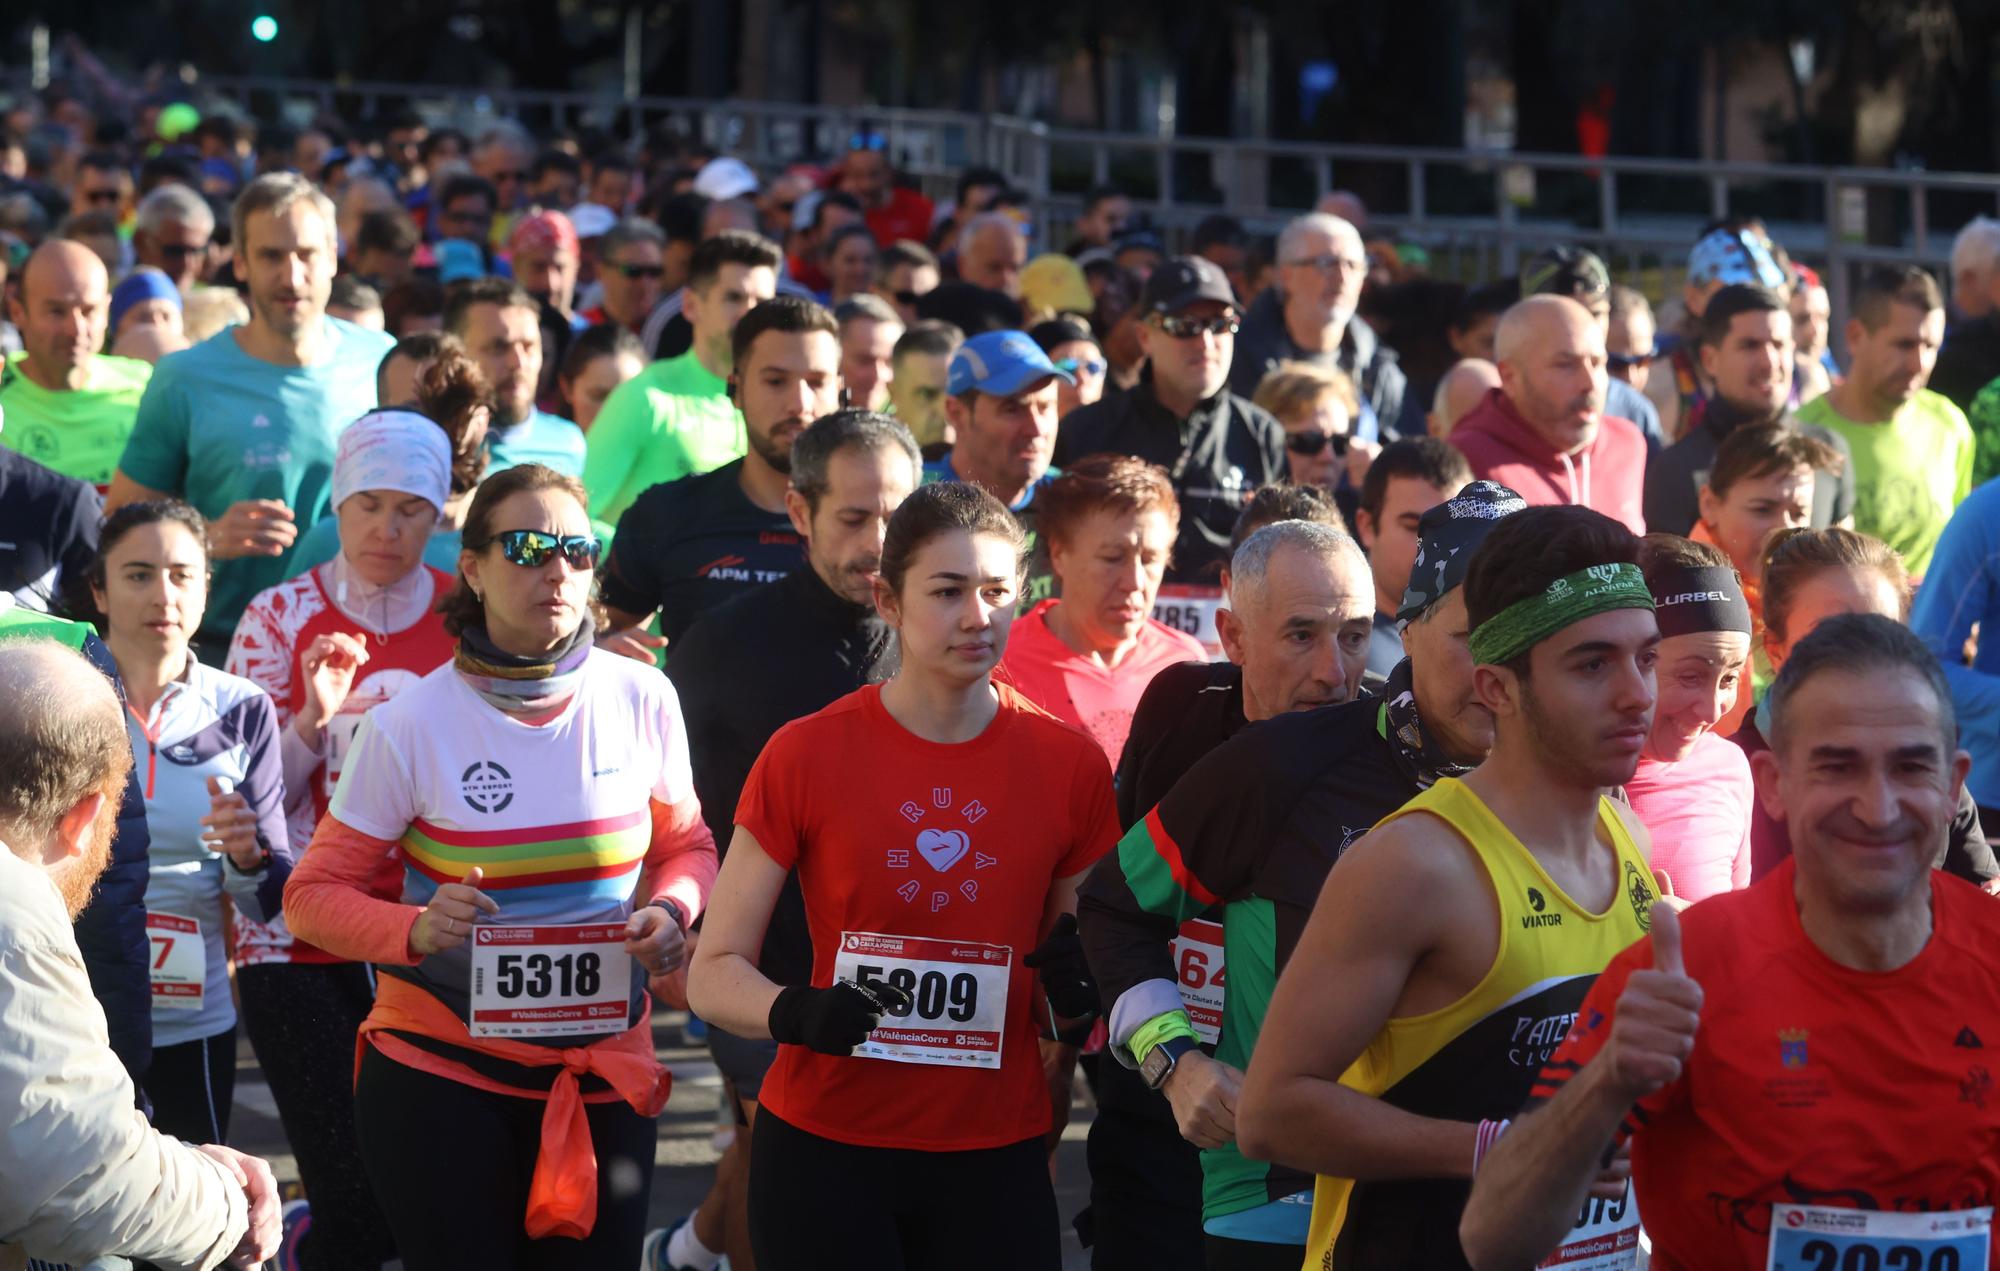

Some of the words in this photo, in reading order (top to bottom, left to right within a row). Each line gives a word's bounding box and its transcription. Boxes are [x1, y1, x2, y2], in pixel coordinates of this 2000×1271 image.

[708, 568, 750, 582] APM
[1654, 590, 1731, 608] LURBEL
[900, 787, 988, 824] RUN
[887, 849, 997, 913] HAPPY
[1522, 913, 1562, 929] VIATOR
[497, 952, 601, 999] 5318
[871, 1029, 949, 1044] #ValènciaCorre
